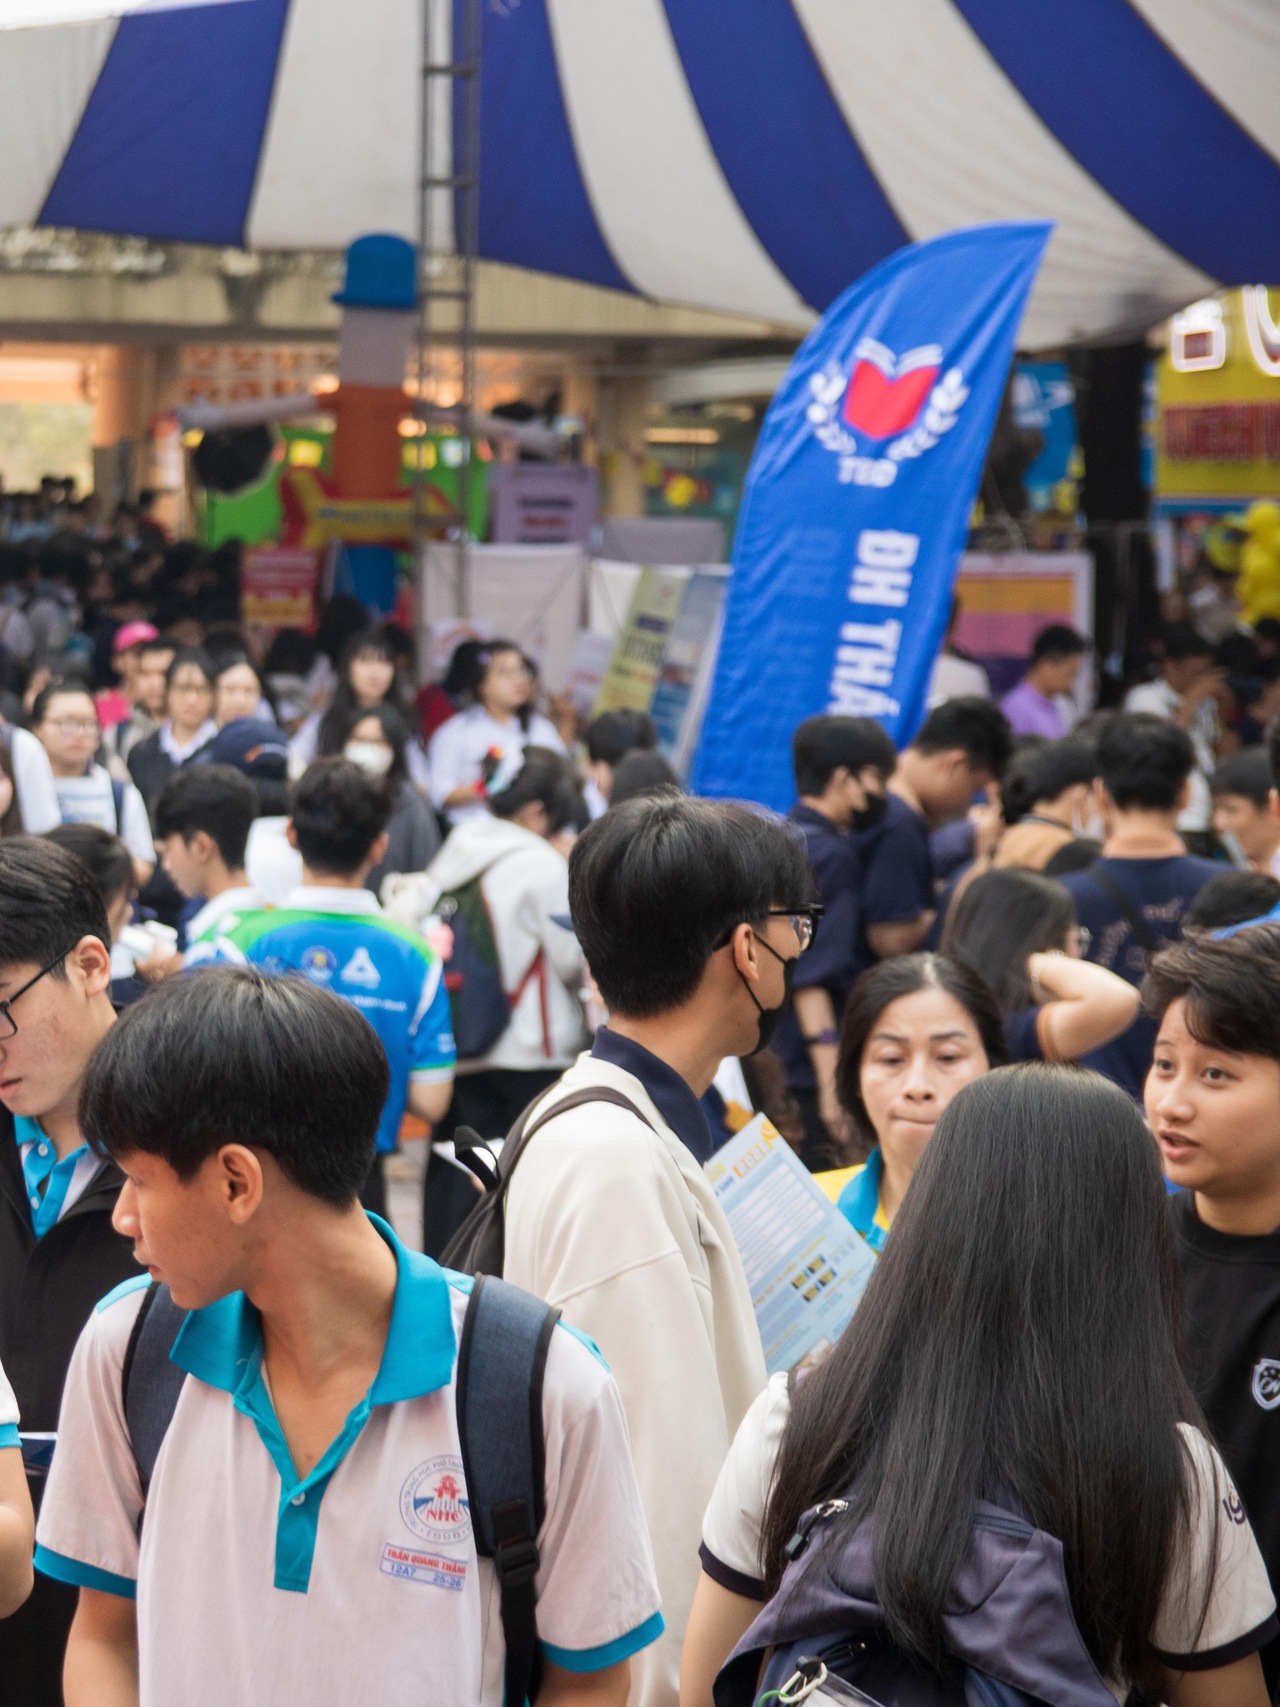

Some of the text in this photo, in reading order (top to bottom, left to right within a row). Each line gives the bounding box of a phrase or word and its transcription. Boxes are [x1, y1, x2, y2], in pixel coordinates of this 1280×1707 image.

[848, 528, 921, 608] ĐH
[825, 618, 903, 717] THÁ
[426, 1509, 464, 1523] NHC
[411, 1554, 439, 1567] QUANG
[391, 1563, 416, 1577] 12A7
